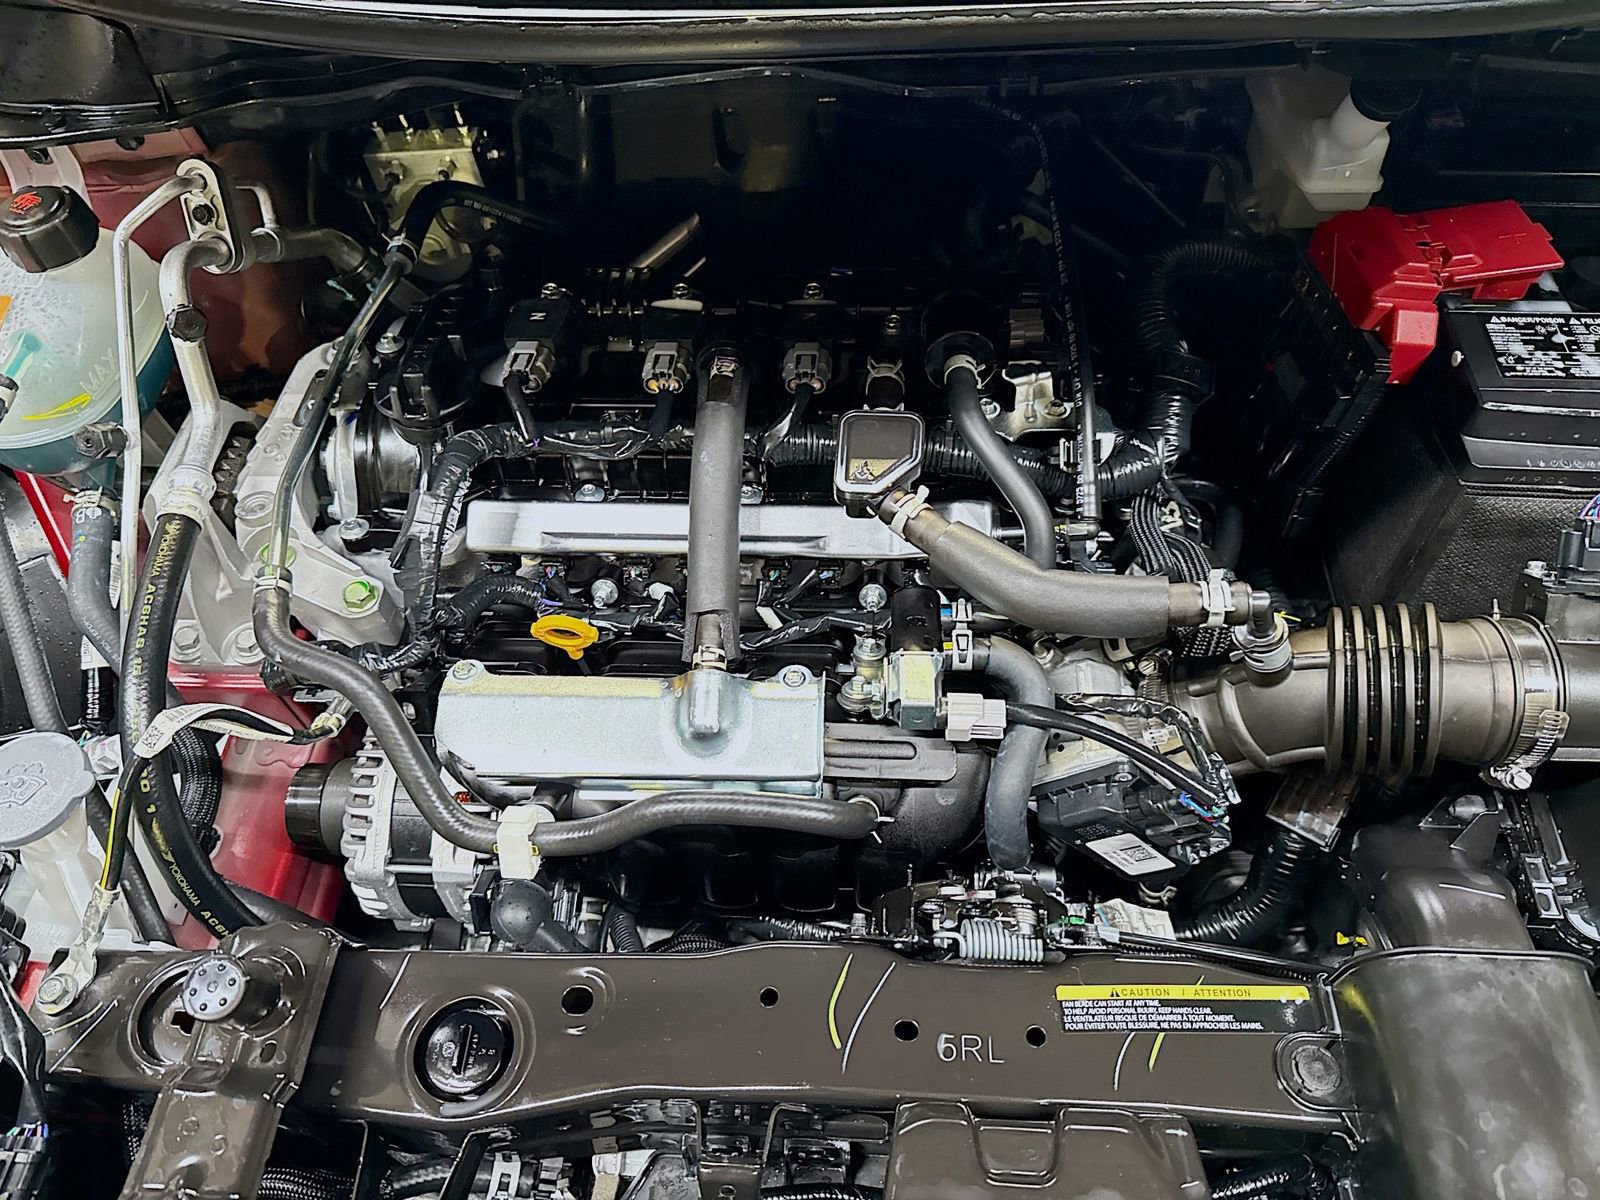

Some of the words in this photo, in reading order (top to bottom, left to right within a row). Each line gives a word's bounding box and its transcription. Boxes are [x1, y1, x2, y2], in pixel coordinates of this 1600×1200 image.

[80, 348, 117, 395] MAX
[151, 534, 171, 577] YOKOHAMA
[168, 861, 201, 907] YOKOHAMA
[1121, 988, 1170, 997] CAUTION
[1194, 988, 1251, 997] ATTENTION
[1074, 1000, 1093, 1008] BLADE
[1172, 1006, 1192, 1014] HANDS
[1193, 1006, 1213, 1014] CLEAR.
[1148, 1013, 1182, 1021] DÉMARRER
[1182, 1013, 1188, 1021] À
[1205, 1014, 1236, 1022] MOMENT.
[1084, 1021, 1106, 1030] ÉVITER
[1128, 1022, 1160, 1030] BLESSURE,
[937, 1032, 1005, 1063] 6RL
